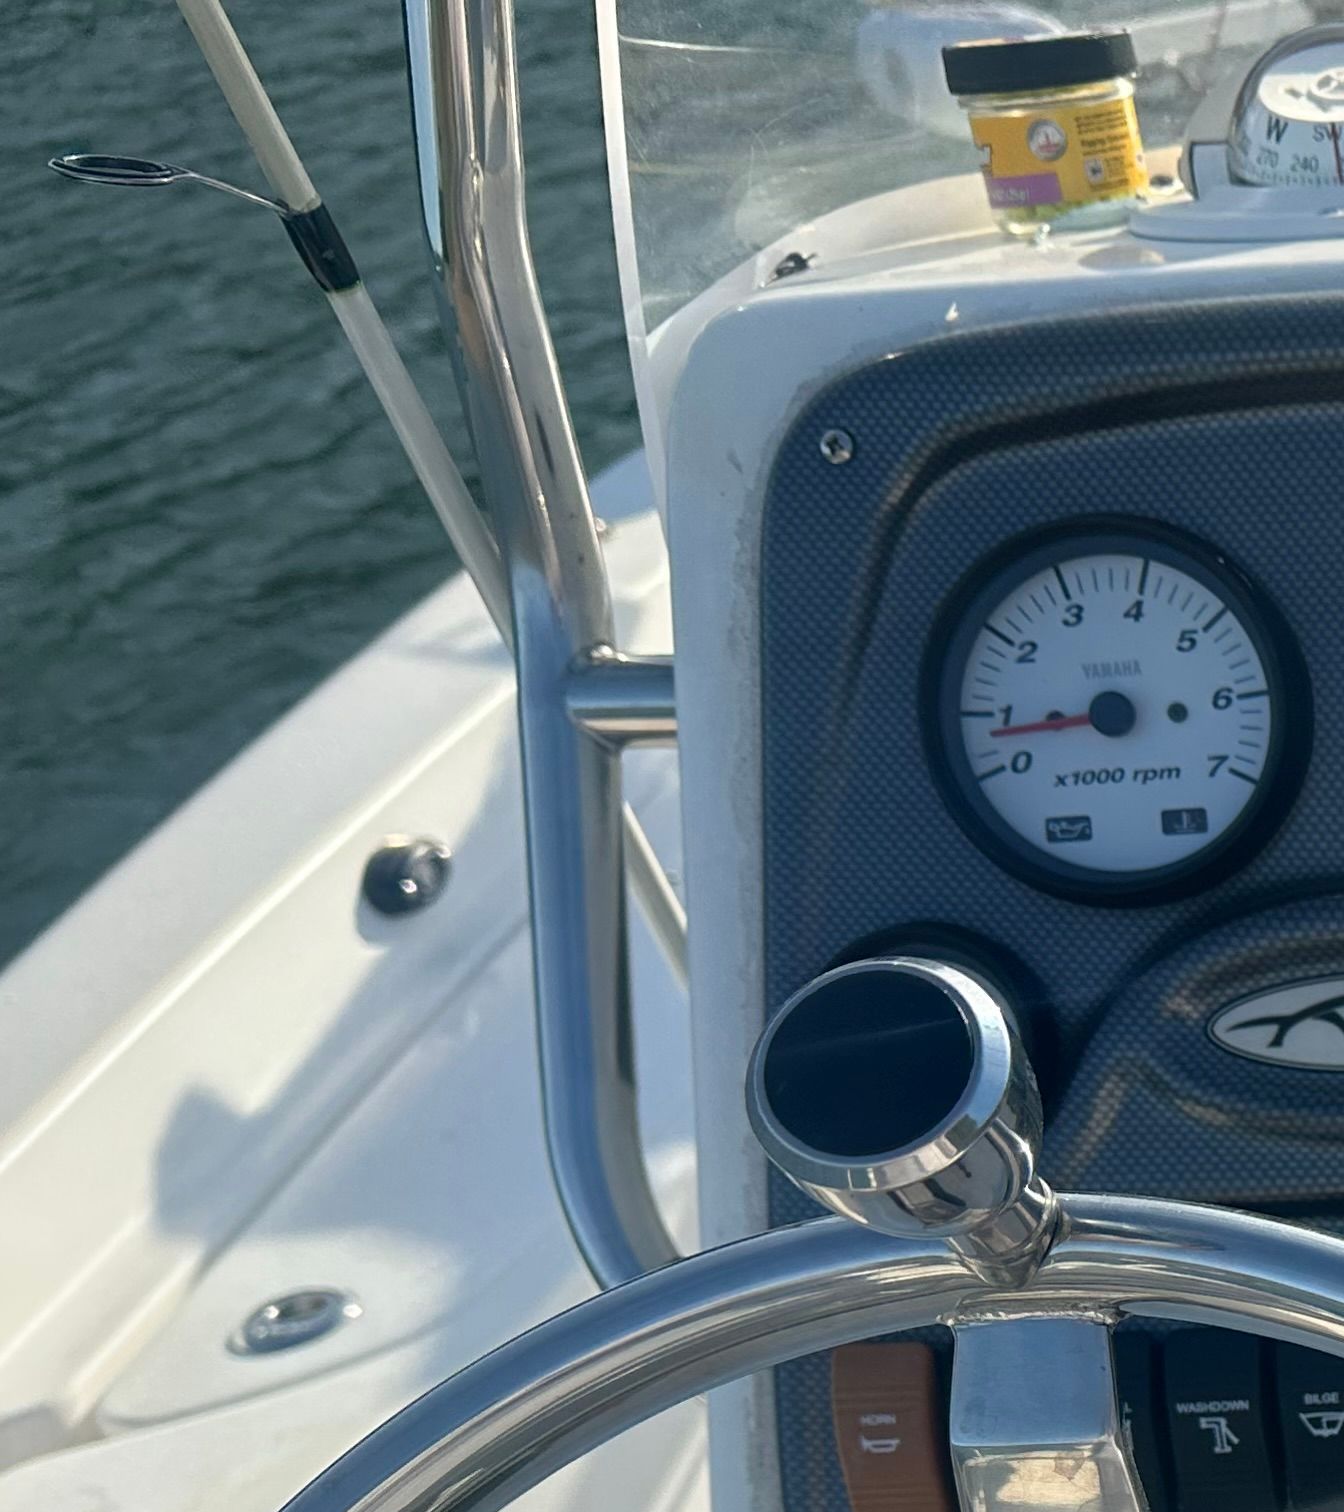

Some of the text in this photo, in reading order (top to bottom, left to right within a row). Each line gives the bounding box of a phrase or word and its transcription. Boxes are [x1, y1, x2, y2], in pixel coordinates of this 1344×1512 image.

[1266, 116, 1288, 144] W
[1313, 125, 1343, 143] SW
[1291, 154, 1319, 172] 240
[1062, 605, 1084, 627] 3
[1123, 600, 1145, 623] 4
[1176, 630, 1198, 652] 5
[1016, 642, 1038, 663] 2
[1081, 660, 1143, 680] YAMAHA
[1212, 688, 1233, 710] 6
[997, 705, 1013, 726] 1
[1011, 751, 1032, 773] 0
[1207, 755, 1229, 777] 7
[1053, 765, 1181, 787] x1000 rpm
[1176, 1400, 1249, 1414] WASHDOWN
[1304, 1392, 1340, 1405] BILGE
[860, 1413, 897, 1427] HORN
